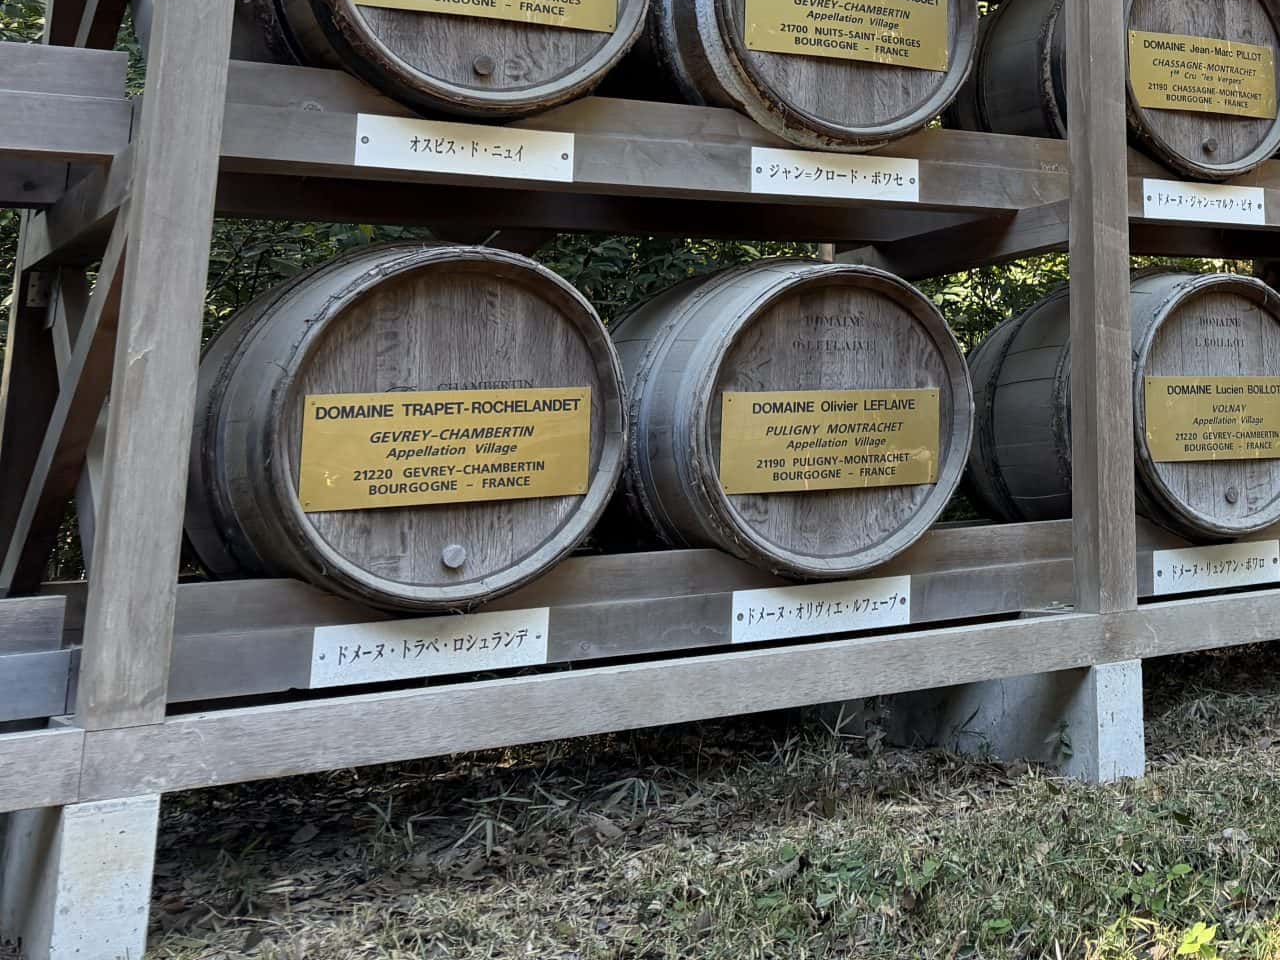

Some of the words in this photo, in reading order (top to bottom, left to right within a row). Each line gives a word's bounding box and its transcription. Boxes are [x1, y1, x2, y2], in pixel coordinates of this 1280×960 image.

[519, 1, 565, 16] FRANCE
[806, 10, 864, 26] Appellation
[869, 17, 900, 30] Village
[780, 23, 808, 34] 21700
[814, 27, 921, 48] NUITS-SAINT-GEORGES
[794, 36, 859, 51] BOURGOGNE
[875, 45, 910, 58] FRANCE
[1143, 39, 1186, 52] DOMAINE
[1189, 44, 1234, 58] Jean-Marc
[1236, 50, 1262, 62] PILLOT
[1152, 58, 1257, 77] CHASSAGNE-MONTRACHET
[1184, 71, 1197, 80] Cru
[1147, 82, 1168, 91] 21190
[1172, 84, 1262, 101] CHASSAGNE-MONTRACHET
[1166, 93, 1213, 104] BOURGOGNE
[1224, 99, 1249, 108] FRANCE
[1167, 384, 1212, 395] DOMAINE
[1215, 385, 1244, 395] Lucien
[1247, 385, 1280, 394] BOILLOT
[315, 403, 394, 420] DOMAINE
[402, 398, 582, 417] TRAPET-ROCHELANDET
[752, 401, 815, 414] DOMAINE
[820, 400, 858, 413] Olivier
[863, 399, 916, 411] LEFLAIVE
[1212, 404, 1247, 413] VOLNAY
[766, 425, 820, 436] PULIGNY
[826, 421, 904, 434] MONTRACHET
[1192, 416, 1237, 426] Appellation
[1240, 416, 1264, 425] Village
[369, 425, 535, 444] GEVREY-CHAMBERTIN
[1175, 432, 1198, 441] 21220
[1202, 430, 1280, 440] GEVREY-CHAMBERTIN
[786, 438, 848, 450] Appellation
[854, 436, 887, 448] Village
[1184, 443, 1234, 452] BOURGOGNE
[1246, 441, 1273, 450] FRANCE
[386, 445, 466, 461] Appellation
[474, 443, 518, 458] Village
[756, 458, 785, 469] 21190
[792, 452, 910, 467] PULIGNY-MONTRACHET
[353, 468, 393, 482] 21220
[402, 461, 546, 479] GEVREY-CHAMBERTIN
[773, 469, 841, 482] BOURGOGNE
[859, 467, 897, 477] FRANCE
[368, 480, 458, 496] BOURGOGNE
[482, 476, 531, 489] FRANCE
